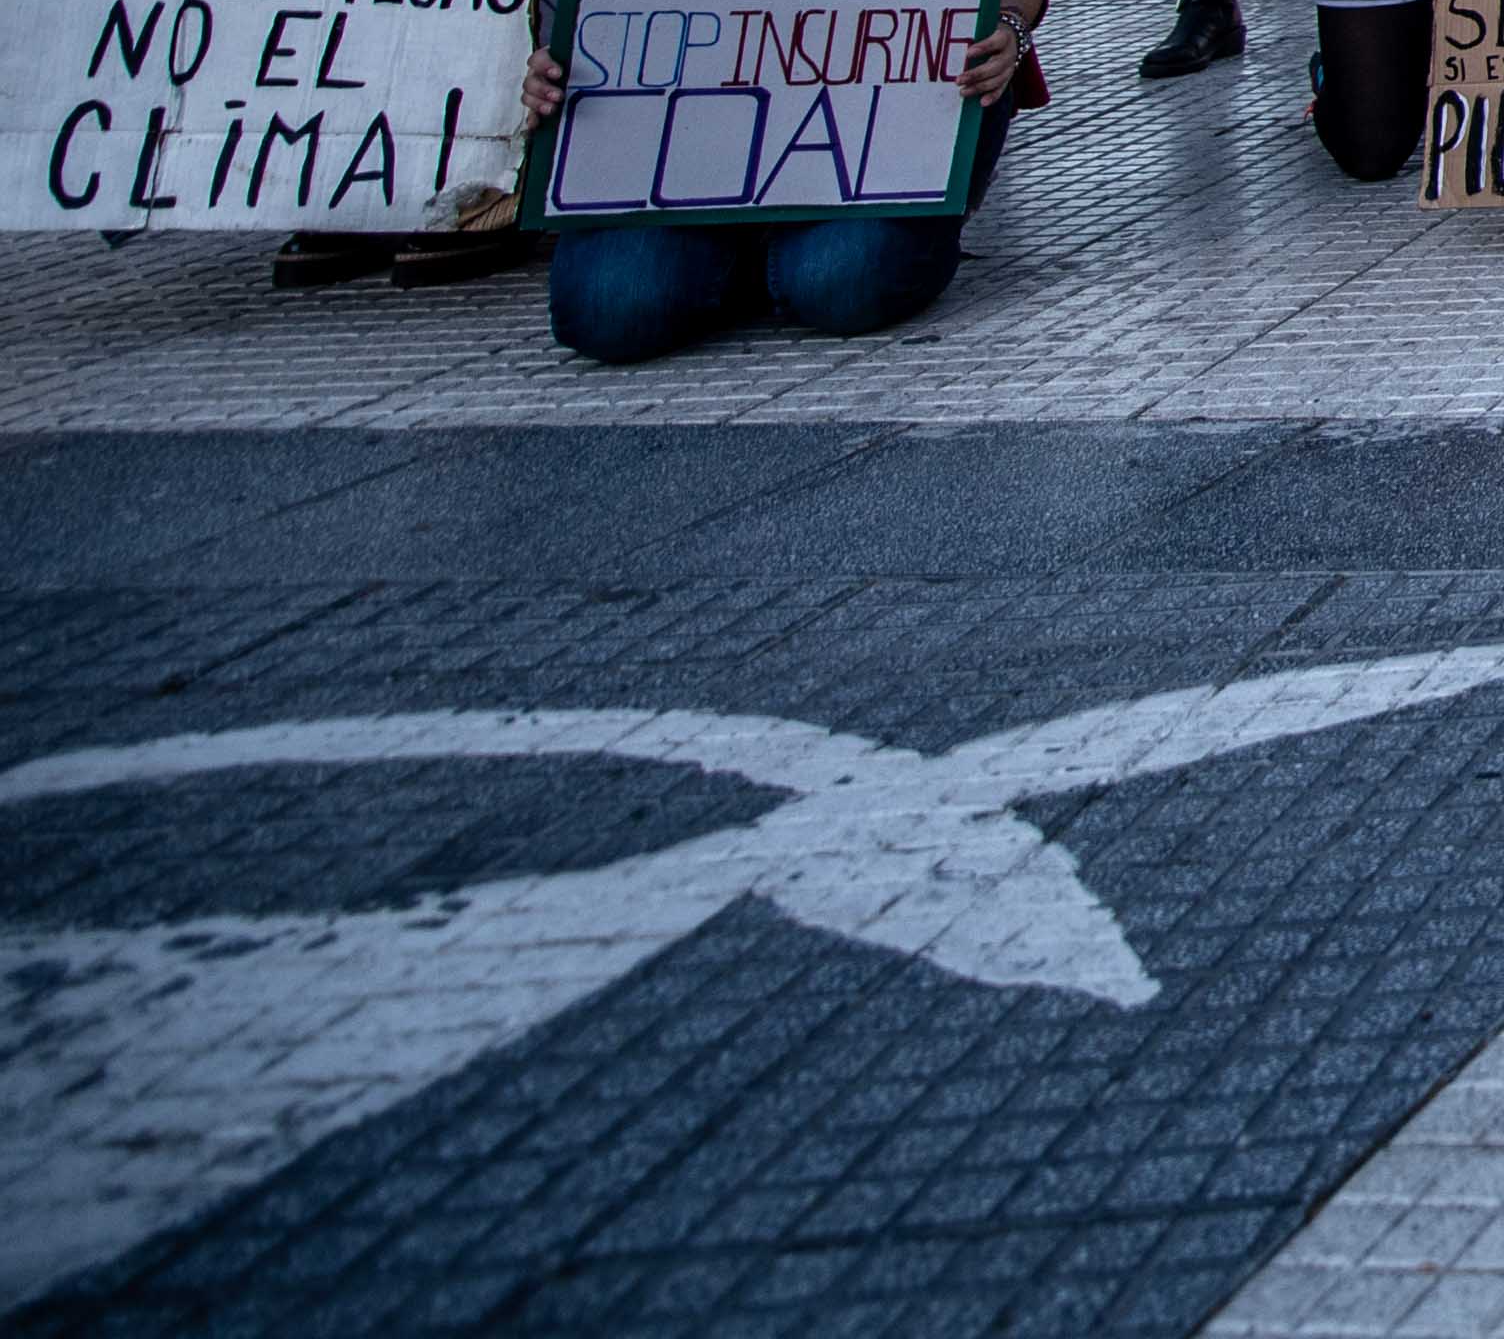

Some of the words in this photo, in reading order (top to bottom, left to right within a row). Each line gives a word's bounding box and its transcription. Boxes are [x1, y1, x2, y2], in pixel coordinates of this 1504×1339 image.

[568, 9, 721, 89] STOP
[1444, 57, 1467, 81] SI
[549, 84, 948, 210] COAL
